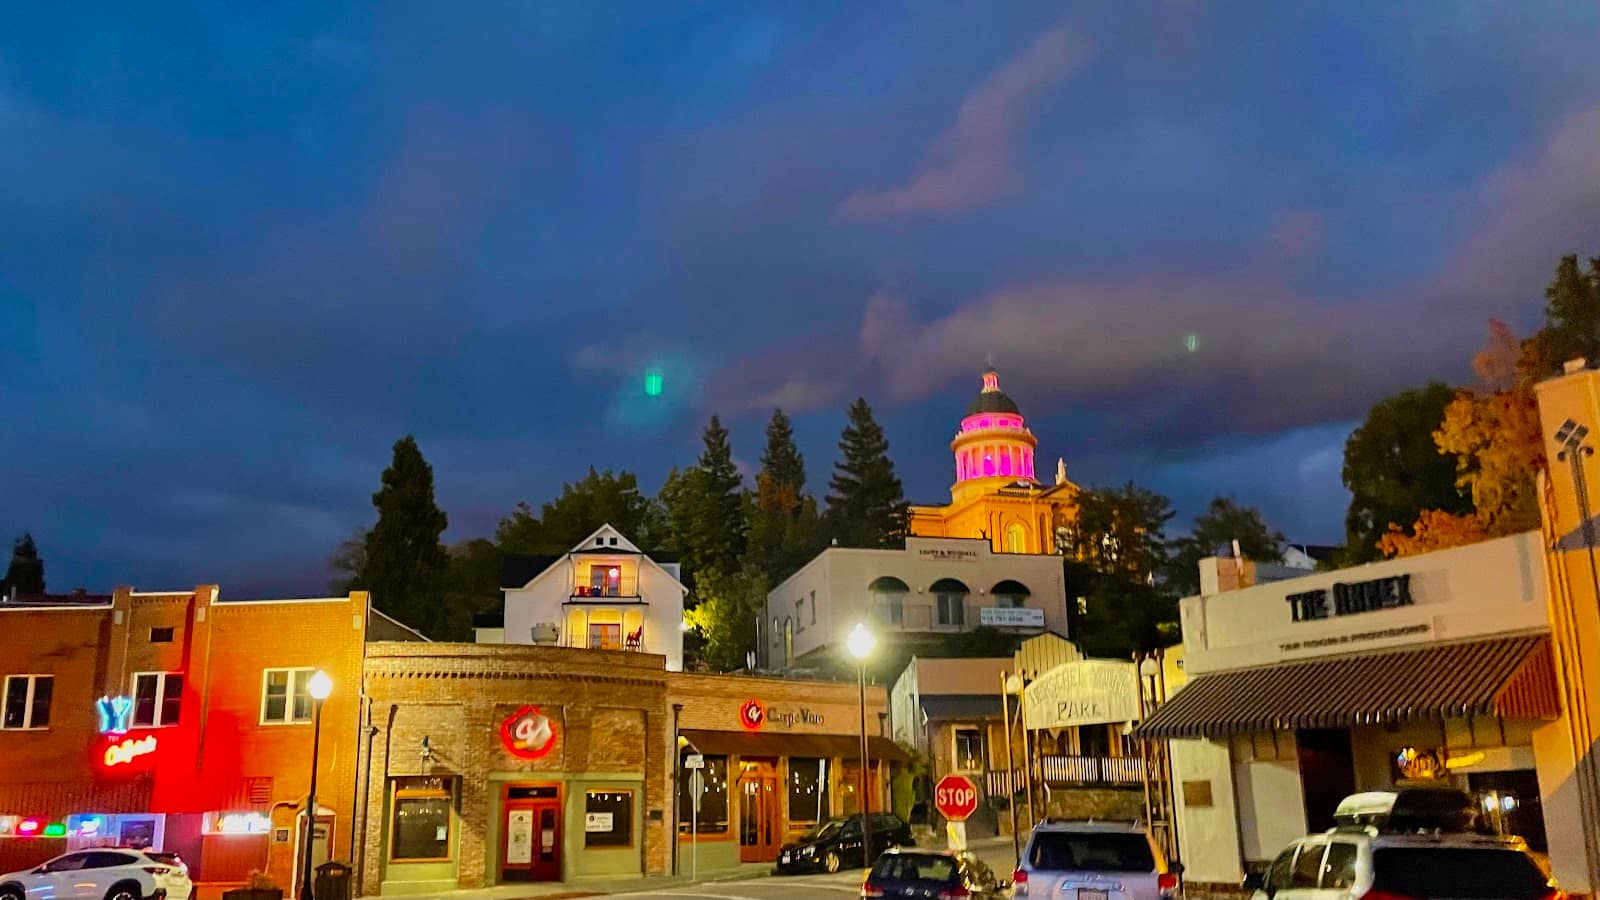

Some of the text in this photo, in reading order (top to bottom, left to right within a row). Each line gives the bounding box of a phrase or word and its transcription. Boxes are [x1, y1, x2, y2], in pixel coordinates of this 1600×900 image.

[1286, 590, 1328, 622] THE
[767, 707, 824, 728] Carpe Vino
[1057, 701, 1101, 720] PARK
[938, 788, 974, 806] STOP
